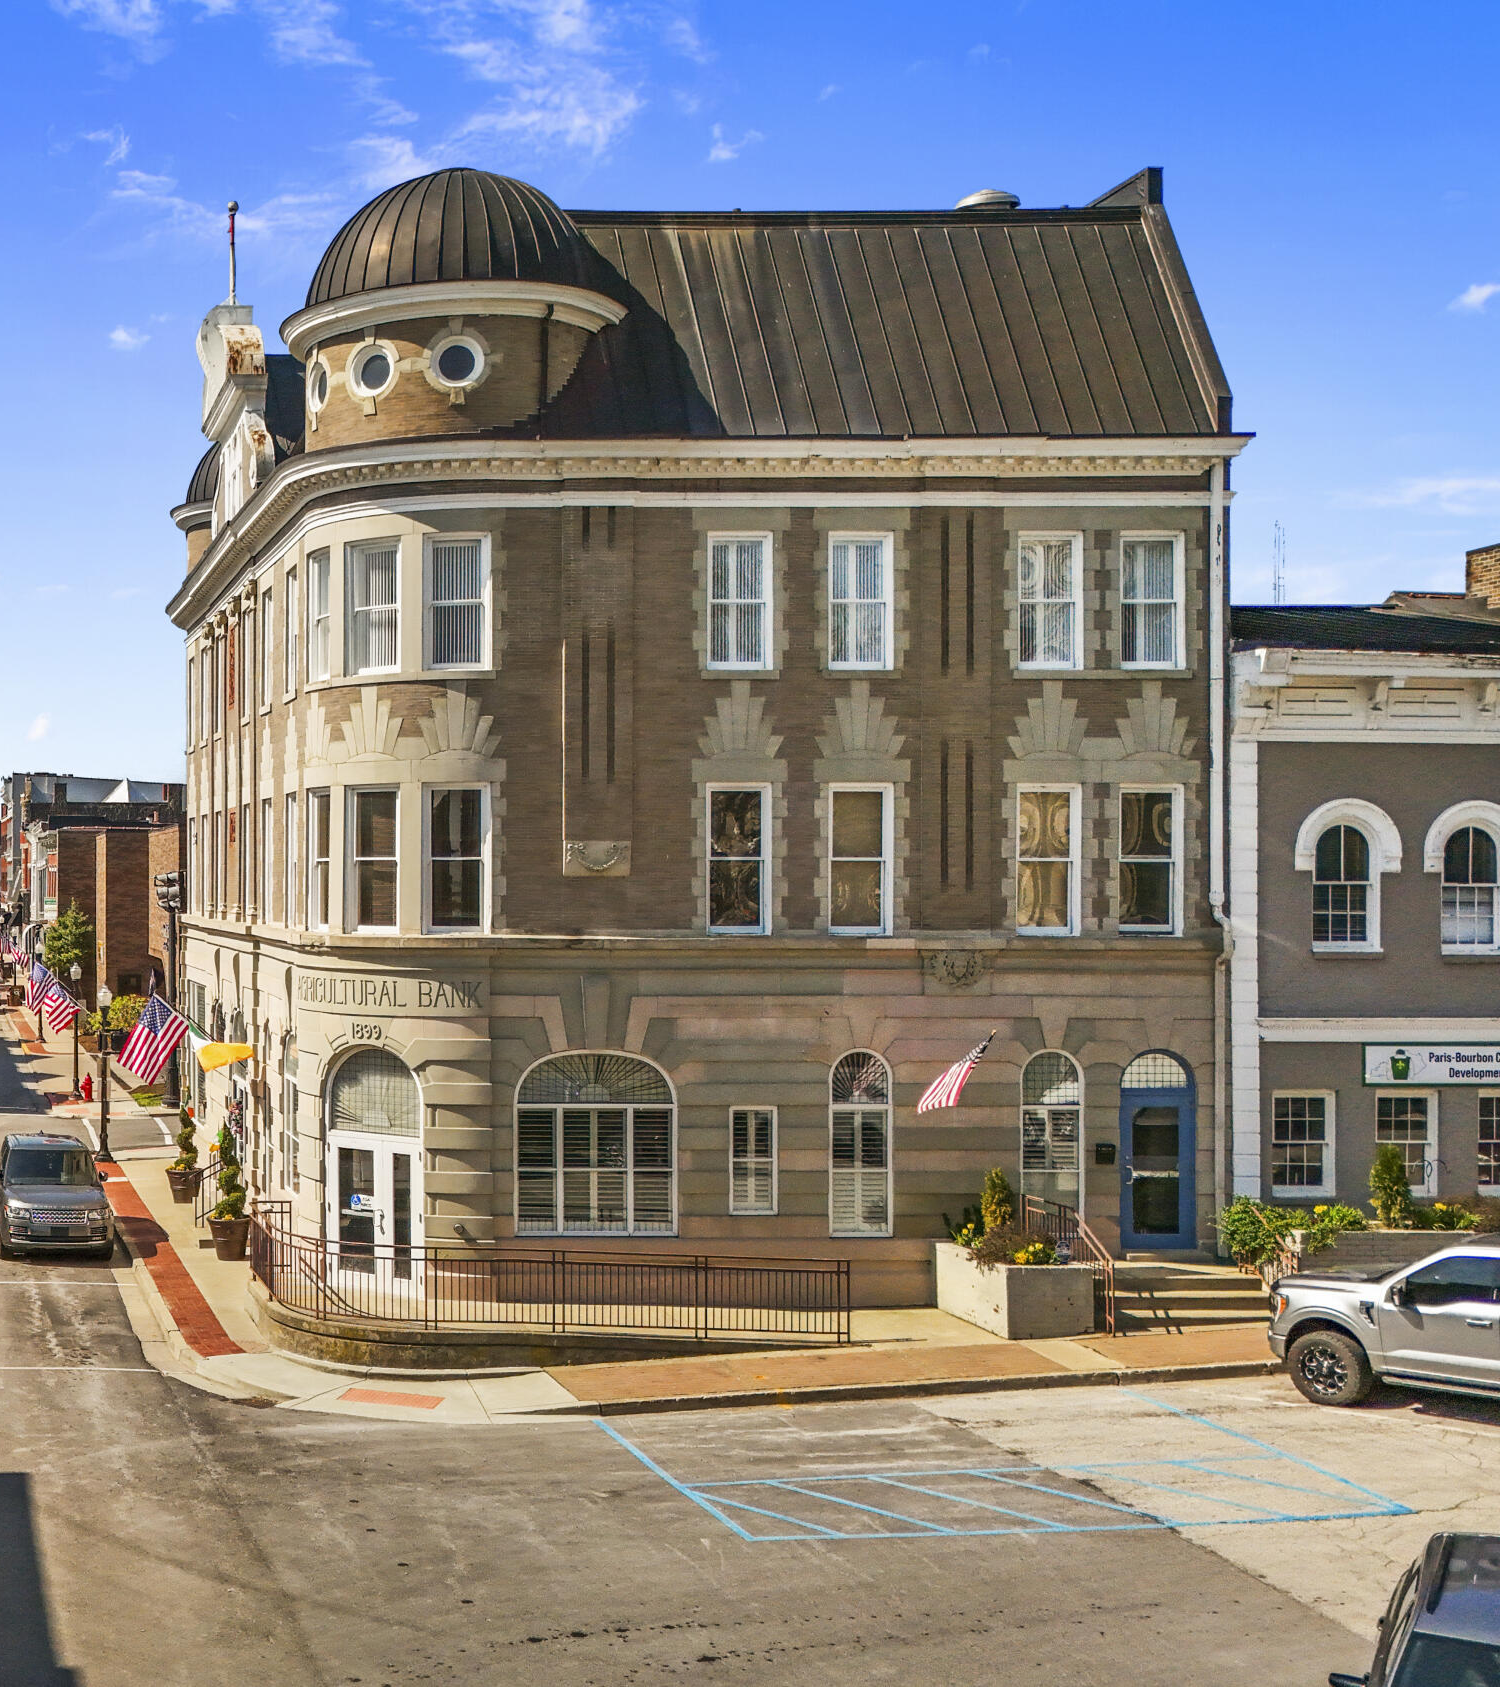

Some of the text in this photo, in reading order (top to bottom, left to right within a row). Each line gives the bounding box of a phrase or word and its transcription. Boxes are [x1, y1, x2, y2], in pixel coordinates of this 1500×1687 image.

[418, 981, 485, 1009] BANK
[351, 1022, 382, 1041] 1899
[1428, 1052, 1493, 1063] Paris-Bourbon
